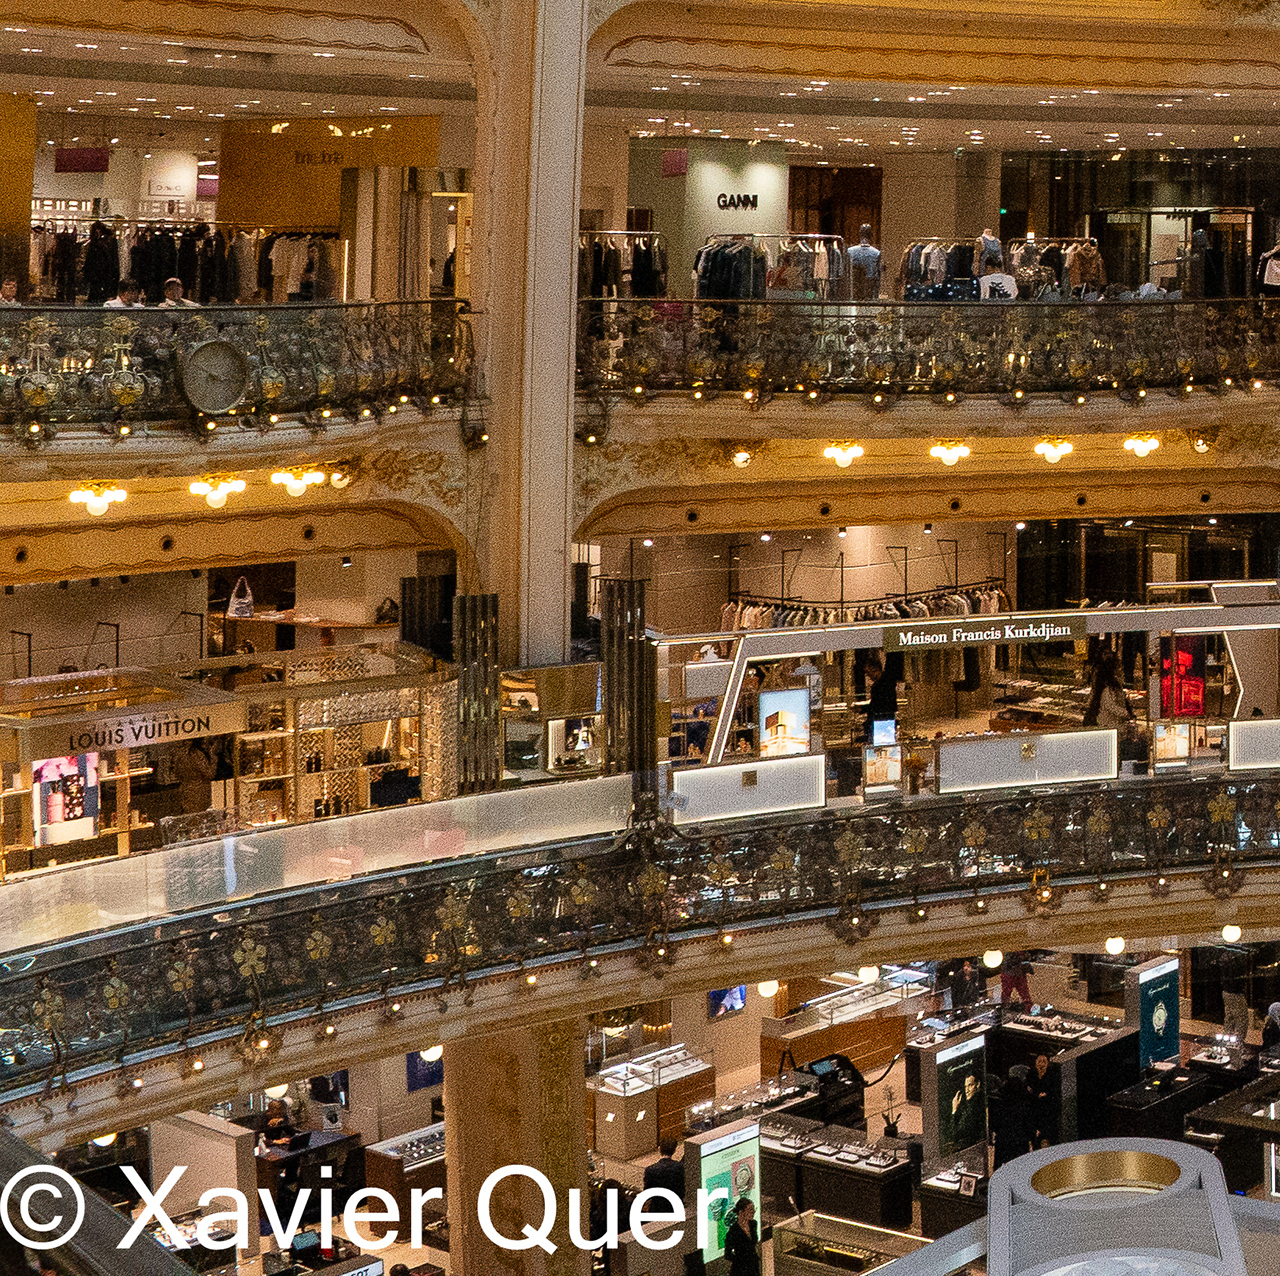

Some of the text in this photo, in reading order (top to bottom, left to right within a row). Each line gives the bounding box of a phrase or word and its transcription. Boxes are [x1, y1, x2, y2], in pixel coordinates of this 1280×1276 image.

[717, 193, 758, 209] GANNI
[899, 623, 1071, 646] Maison Francis Kurkdjian
[70, 716, 210, 750] LOUIS VUITTON
